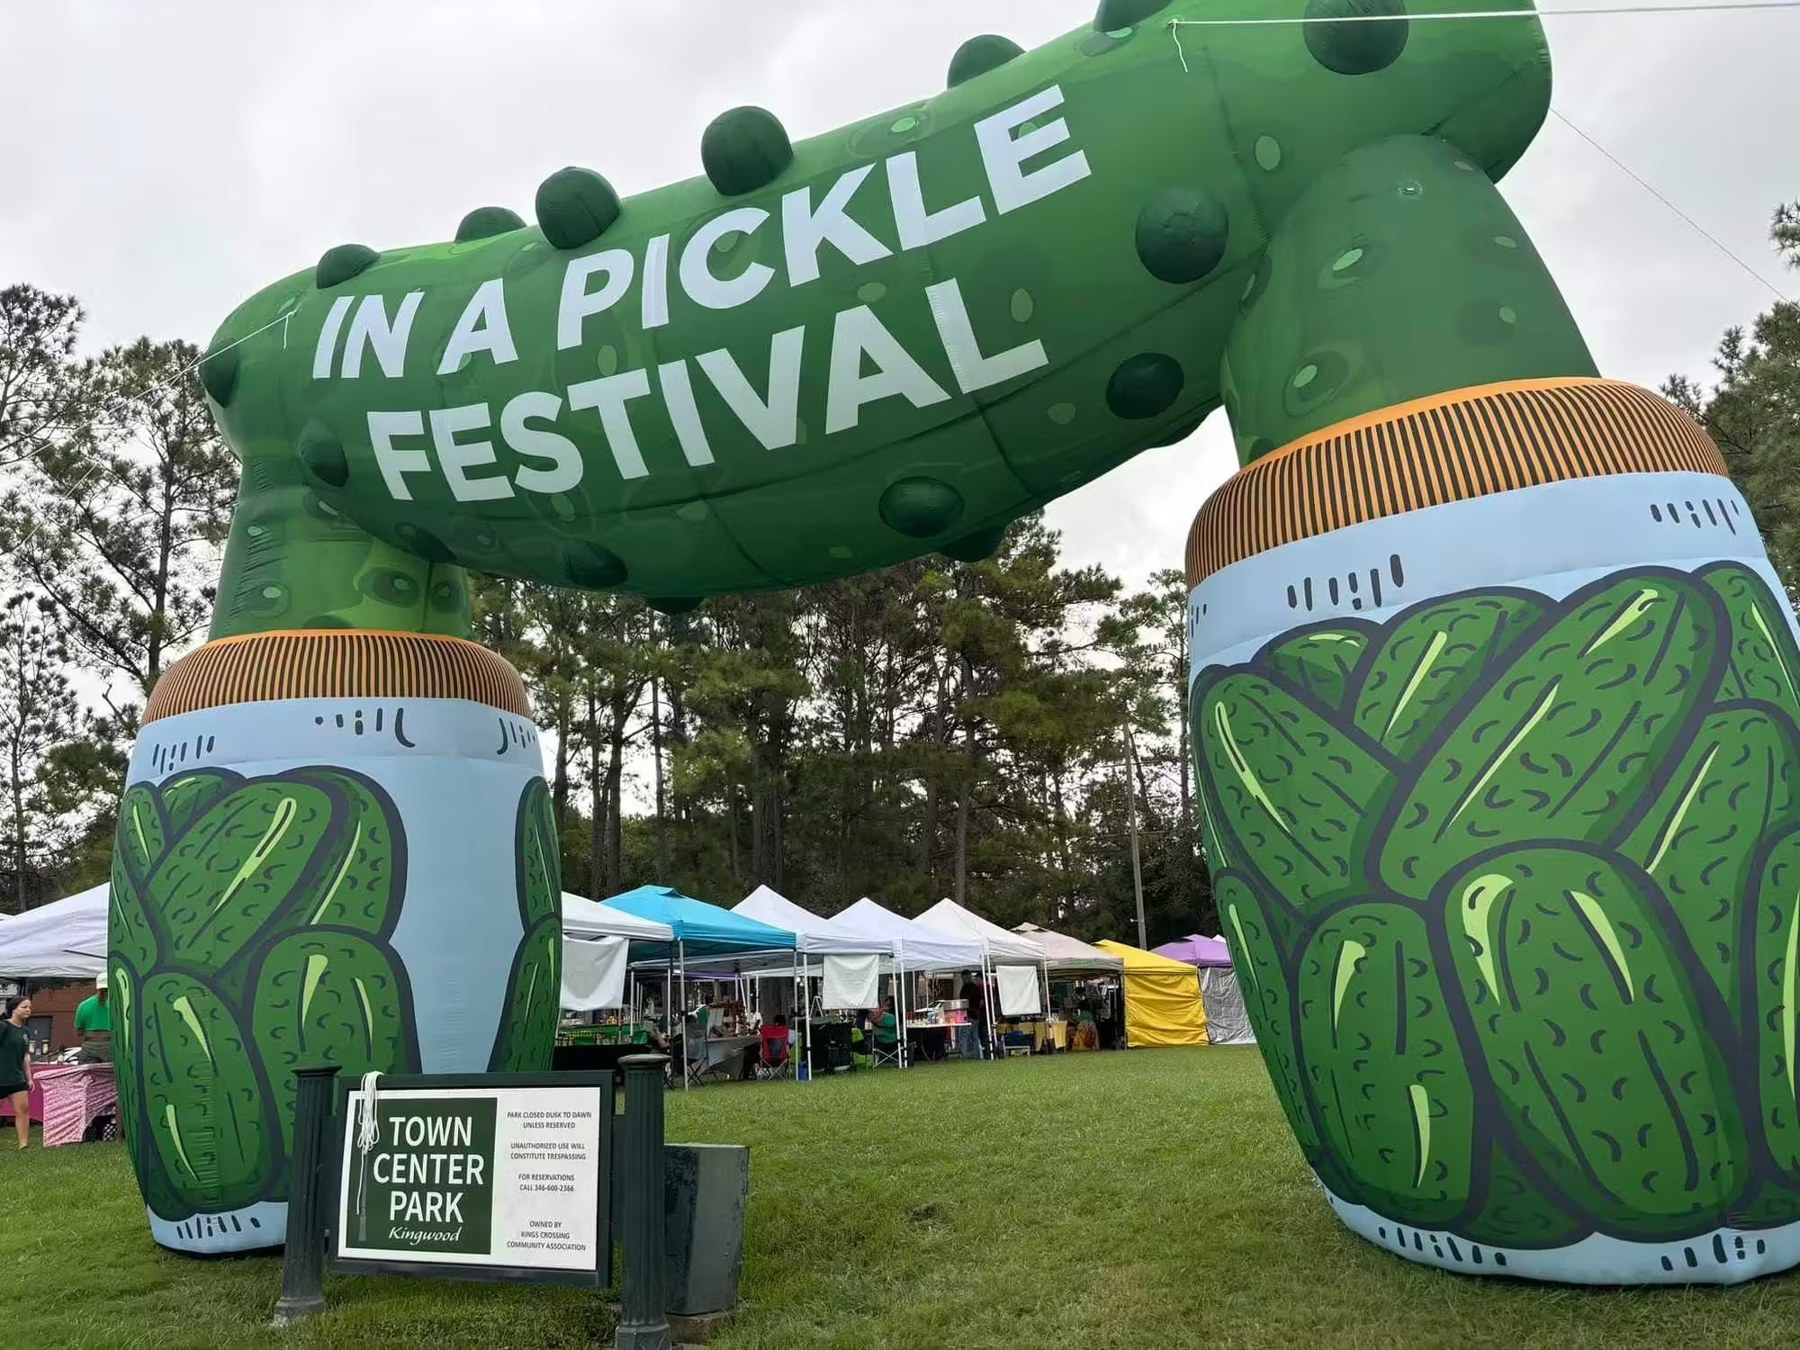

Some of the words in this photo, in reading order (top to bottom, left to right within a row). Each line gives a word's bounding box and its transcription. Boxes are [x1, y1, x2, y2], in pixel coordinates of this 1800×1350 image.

[312, 290, 424, 380] IN
[436, 277, 519, 376] A
[556, 84, 1092, 351] PICKLE
[366, 277, 1050, 503] FESTIVAL
[507, 1111, 522, 1119] PARK
[523, 1111, 545, 1119] CLOSED
[546, 1111, 561, 1119] DUSK
[563, 1111, 571, 1119] TO
[572, 1111, 592, 1119] DAWN
[389, 1116, 473, 1147] TOWN
[510, 1142, 557, 1150] UNAUTHORIZED
[558, 1142, 569, 1150] USE
[571, 1142, 585, 1150] WILL
[510, 1152, 546, 1160] CONSTITUTE
[547, 1152, 586, 1160] TRESPASSING
[373, 1153, 485, 1185] CENTER
[531, 1173, 575, 1181] RESERVATIONS
[389, 1191, 464, 1223] PARK
[529, 1220, 553, 1228] OWNED
[388, 1226, 463, 1246] Kingwood
[520, 1231, 539, 1239] KINGS
[540, 1231, 570, 1239] CROSSING
[506, 1240, 545, 1249] COMMUNITY
[546, 1243, 586, 1251] ASSOCIATION
